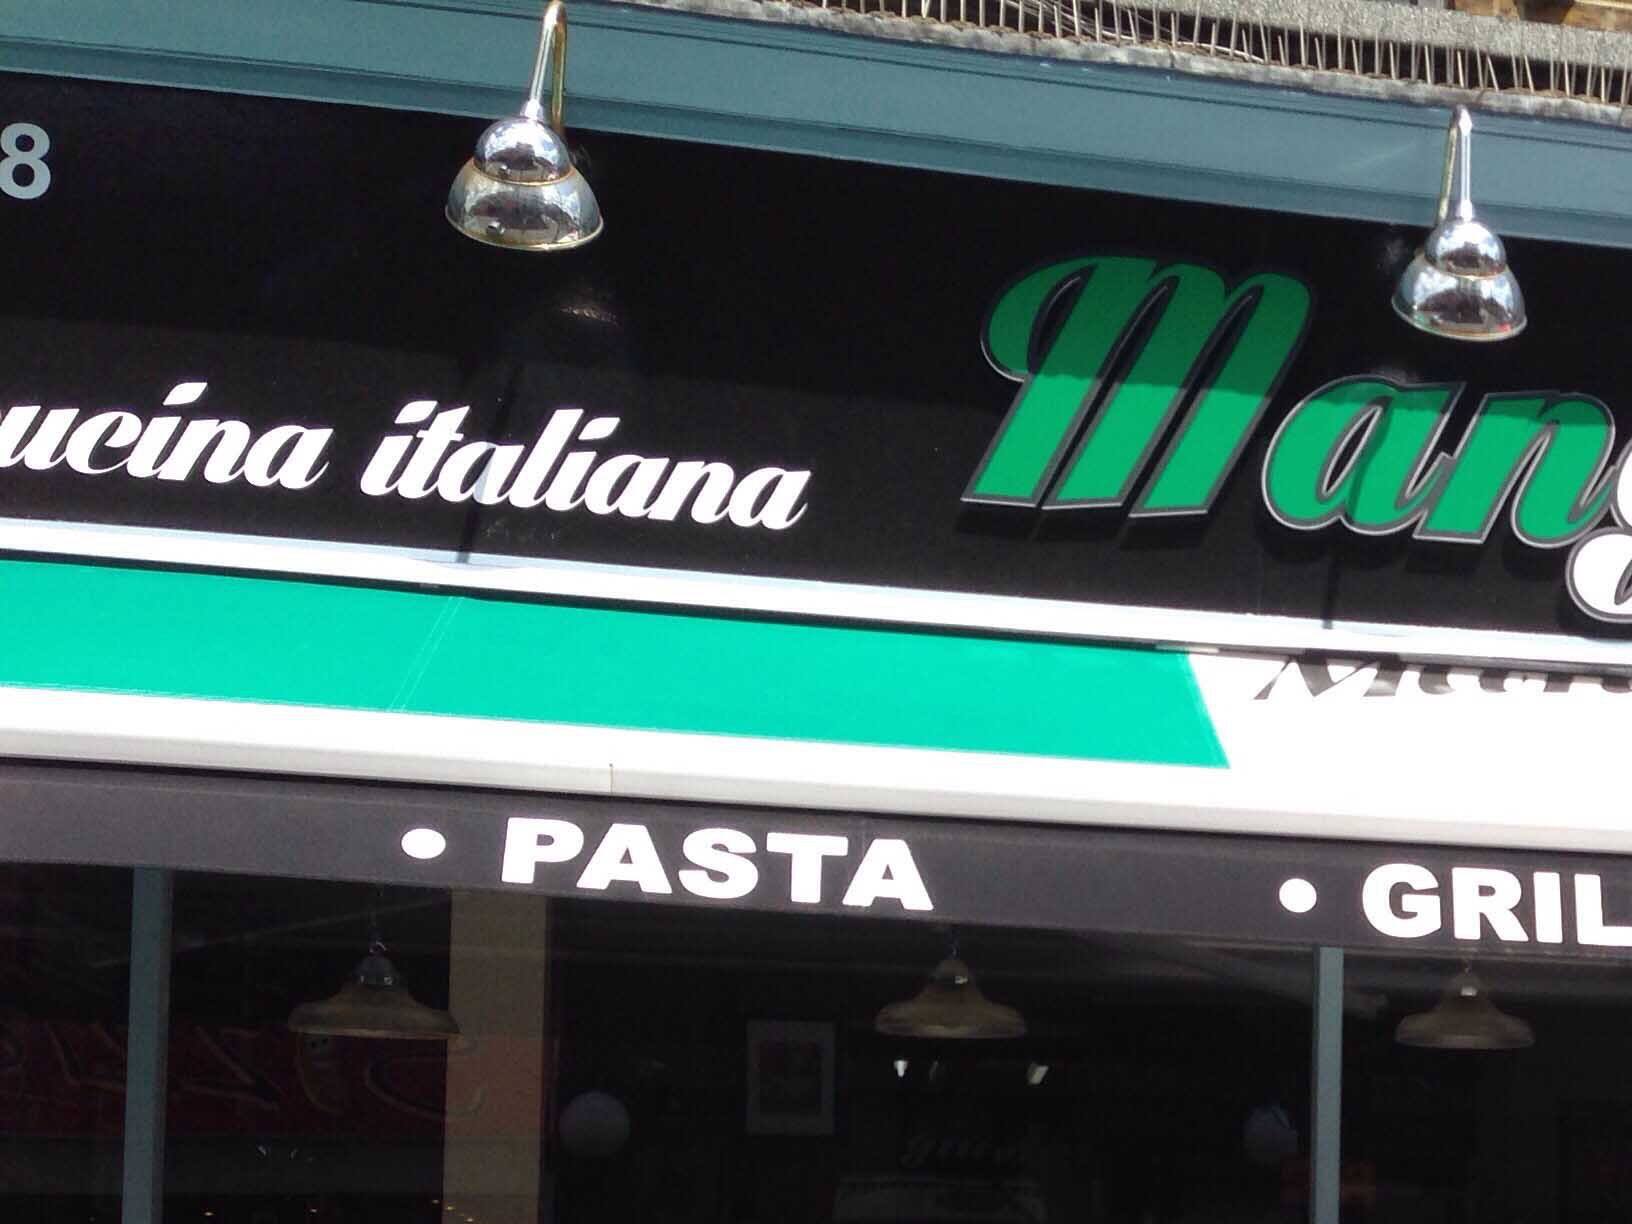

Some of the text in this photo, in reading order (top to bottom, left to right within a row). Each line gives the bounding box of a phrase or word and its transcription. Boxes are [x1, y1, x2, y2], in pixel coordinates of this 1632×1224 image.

[0, 122, 51, 200] 8
[359, 399, 812, 531] italiana
[501, 816, 935, 912] PASTA
